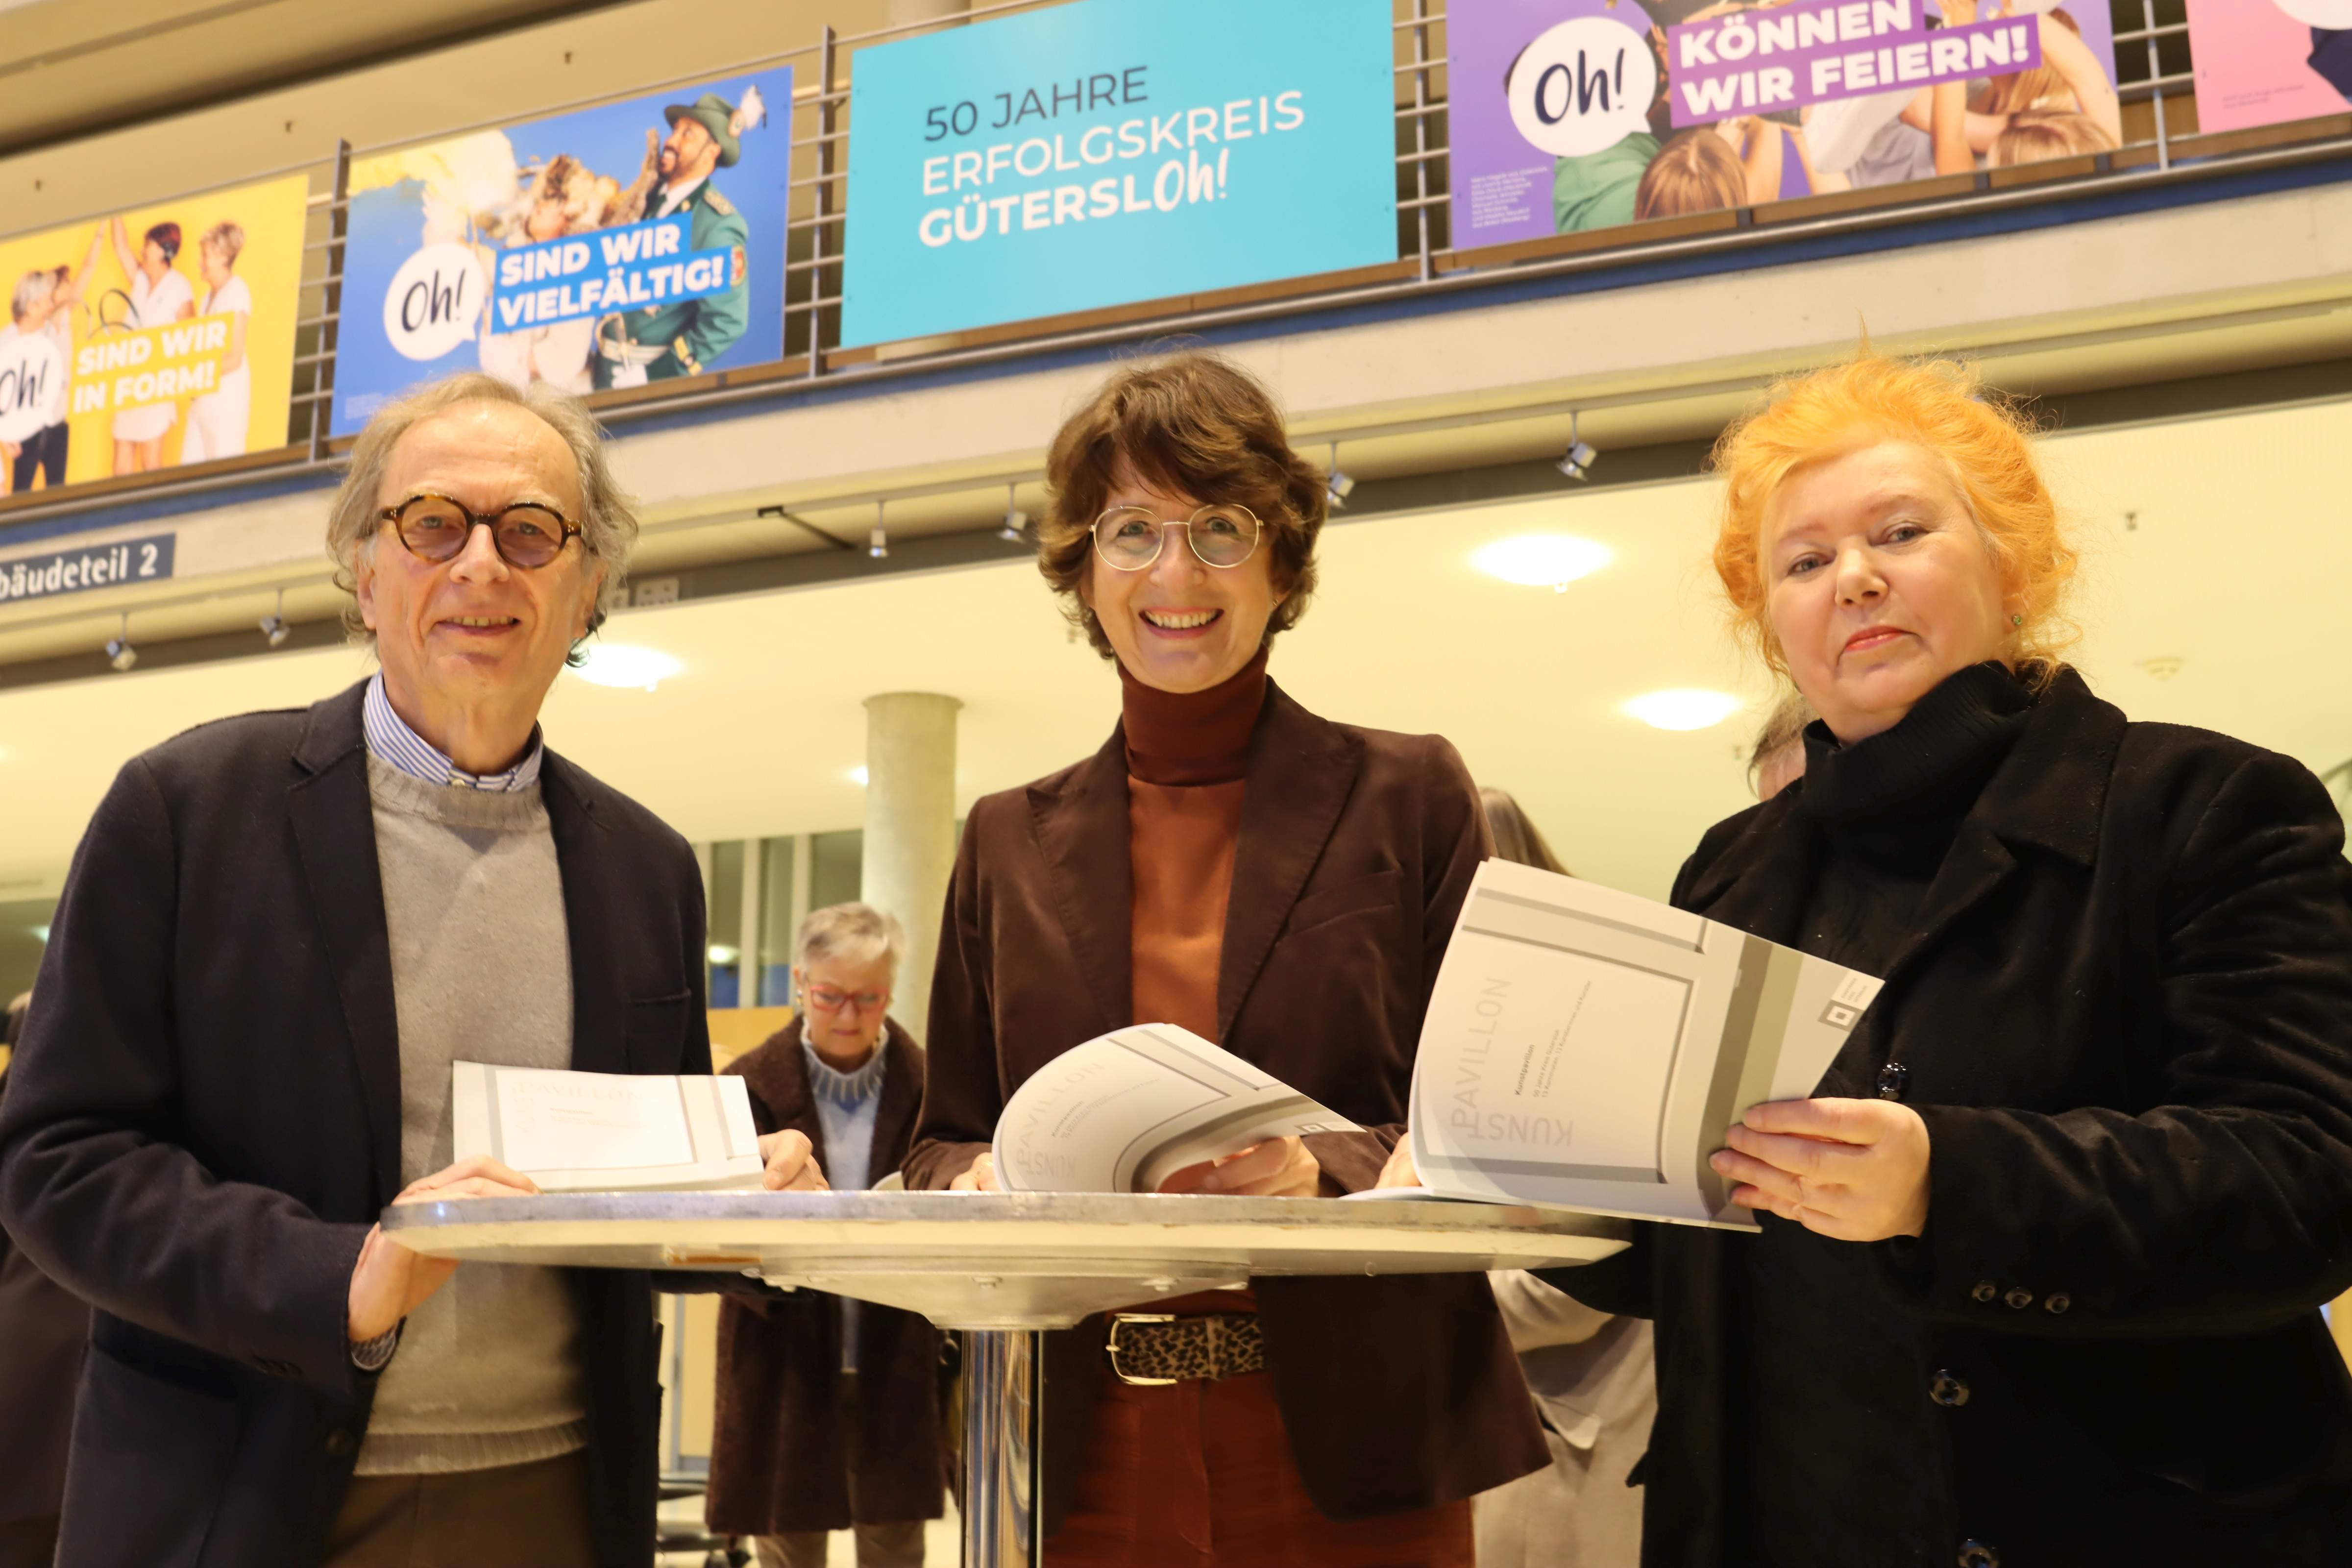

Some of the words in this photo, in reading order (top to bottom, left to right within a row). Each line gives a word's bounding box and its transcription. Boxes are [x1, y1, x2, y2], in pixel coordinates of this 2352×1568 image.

[1679, 0, 1912, 69] KÖNNEN
[924, 101, 978, 142] 50
[991, 65, 1149, 129] JAHRE
[1534, 48, 1624, 125] Oh!
[1681, 66, 1796, 116] WIR
[1811, 24, 2030, 97] FEIERN!
[923, 90, 1305, 196] ERFOLGSKREIS
[500, 241, 590, 286] SIND
[600, 223, 681, 266] WIR
[401, 268, 466, 334] Oh!
[497, 255, 725, 327] VIELFÄLTIG!
[76, 337, 151, 376] SIND
[161, 319, 228, 359] WIR
[73, 381, 105, 414] IN
[114, 360, 216, 405] FORM!
[139, 543, 158, 576] 2
[1451, 978, 1512, 1128] PAVILLON
[1514, 1044, 1535, 1096] Kunstpavillon
[1016, 1063, 1105, 1166] PAVILLON
[1468, 1111, 1573, 1146] KUNST
